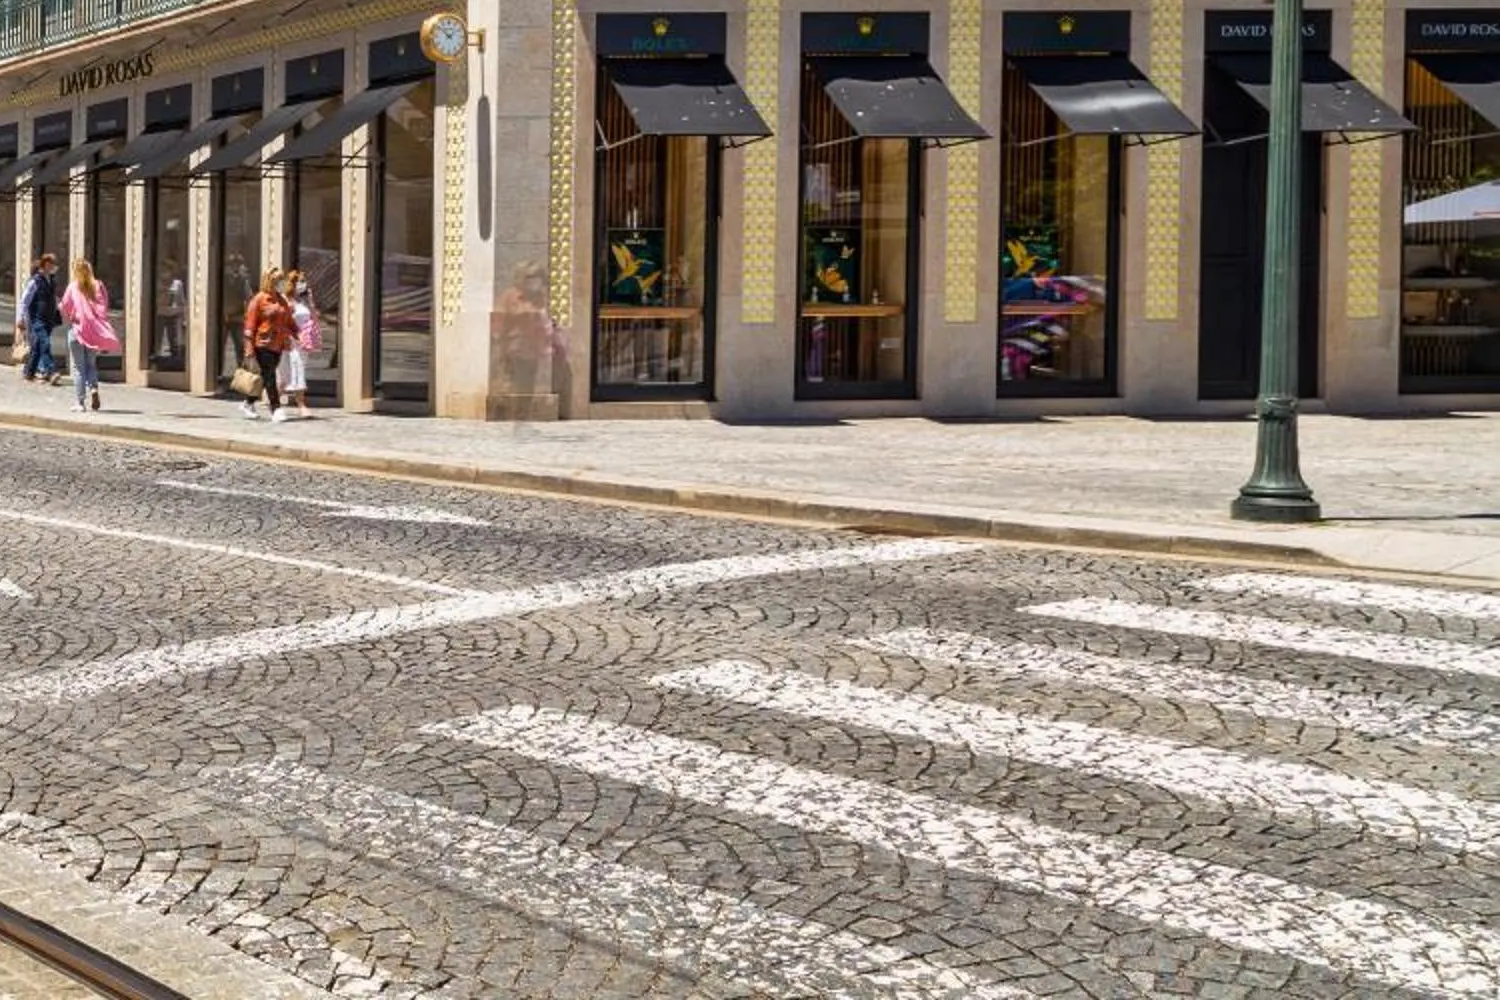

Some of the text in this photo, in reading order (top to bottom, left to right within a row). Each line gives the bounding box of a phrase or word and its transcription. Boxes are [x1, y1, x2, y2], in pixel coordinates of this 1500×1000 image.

[1221, 23, 1267, 37] DAVID
[1420, 23, 1467, 36] DAVID
[60, 50, 153, 97] DAVID ROSAS
